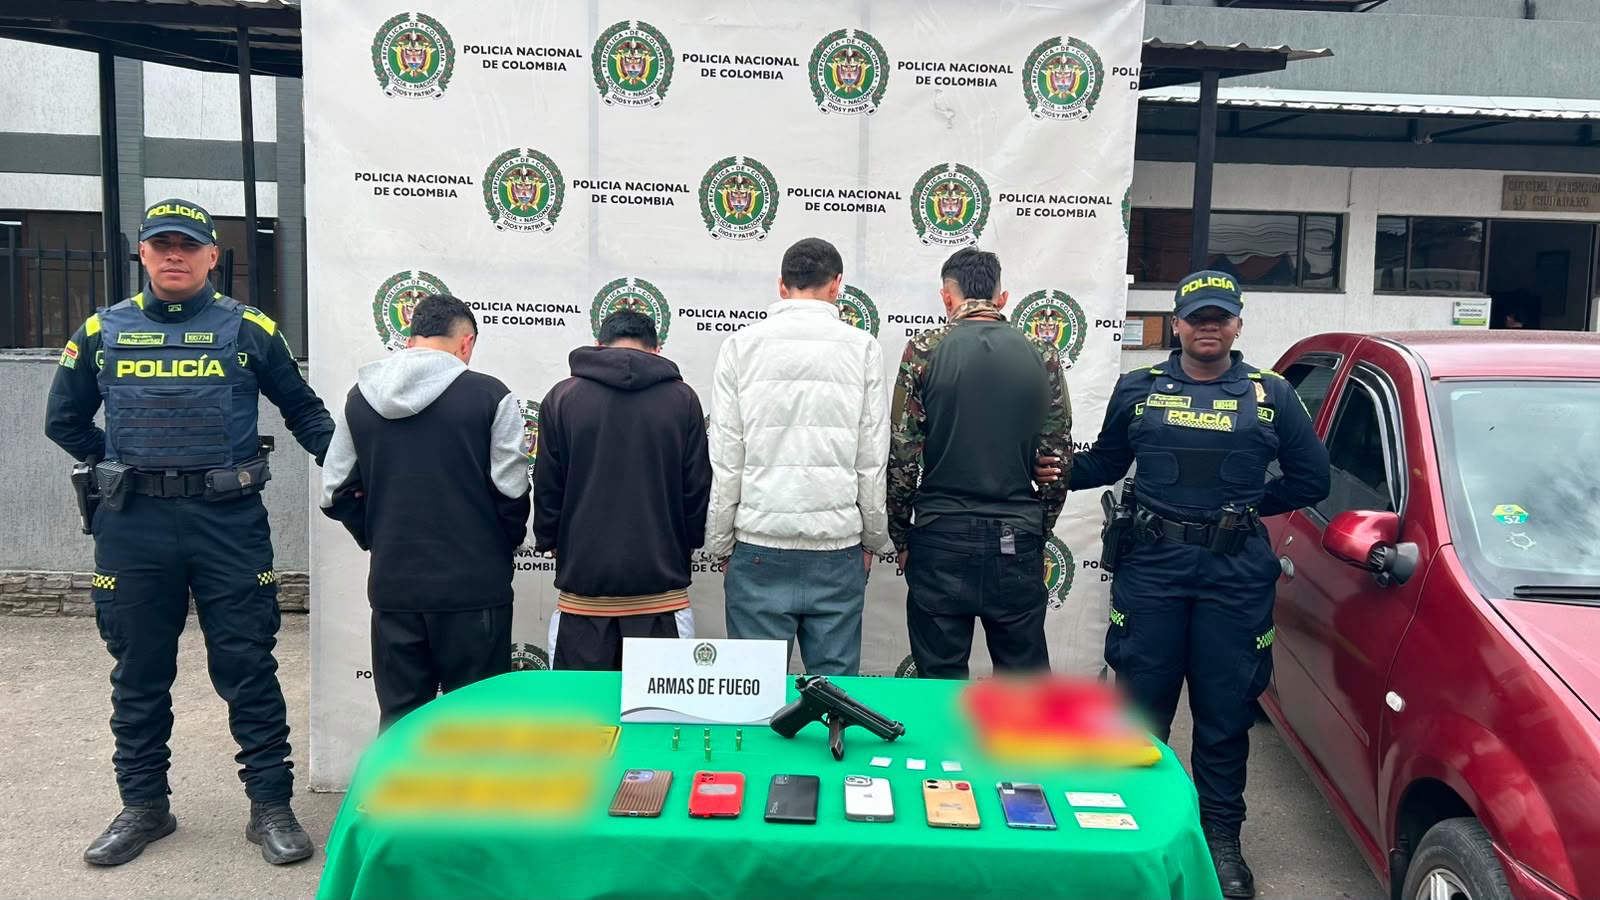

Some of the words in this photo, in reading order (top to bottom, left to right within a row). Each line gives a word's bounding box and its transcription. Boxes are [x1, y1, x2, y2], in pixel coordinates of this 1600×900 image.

[381, 25, 404, 60] REPUBLICA
[424, 26, 445, 62] COLOMBIA
[464, 45, 512, 55] POLICIA
[517, 47, 582, 57] NACIONAL
[601, 33, 624, 69] REPUBLICA
[644, 34, 664, 71] COLOMBIA
[483, 60, 497, 68] DE
[502, 61, 566, 71] COLOMBIA
[683, 54, 730, 64] POLICIA
[735, 56, 799, 66] NACIONAL
[817, 42, 840, 77] REPUBLICA
[860, 43, 880, 79] COLOMBIA
[898, 62, 945, 71] POLICIA
[950, 63, 1013, 73] NACIONAL
[1032, 49, 1054, 83] REPUBLICA
[1074, 50, 1094, 85] COLOMBIA
[1113, 67, 1138, 76] POLI
[386, 67, 407, 88] POLICIA
[413, 68, 442, 89] NACIONAL
[701, 69, 716, 77] DE
[720, 69, 783, 79] COLOMBIA
[606, 76, 627, 97] POLICIA
[633, 77, 662, 98] NACIONAL
[916, 76, 930, 84] DE
[935, 77, 997, 87] COLOMBIA
[413, 87, 436, 98] PATRIA
[822, 84, 843, 104] POLICIA
[849, 85, 877, 106] NACIONAL
[633, 96, 655, 107] PATRIA
[1037, 90, 1057, 110] POLICIA
[1063, 91, 1091, 111] NACIONAL
[849, 104, 871, 114] PATRIA
[1063, 109, 1085, 119] PATRIA
[355, 173, 403, 182] POLICIA
[408, 174, 473, 184] NACIONAL
[492, 161, 514, 195] REPUBLICA
[535, 162, 555, 198] COLOMBIA
[574, 180, 621, 190] POLICIA
[626, 182, 689, 192] NACIONAL
[708, 168, 730, 203] REPUBLICA
[750, 169, 770, 205] COLOMBIA
[375, 187, 389, 195] DE
[394, 188, 457, 197] COLOMBIA
[788, 188, 834, 197] POLICIA
[839, 190, 901, 199] NACIONAL
[920, 175, 942, 209] REPUBLICA
[962, 176, 982, 211] COLOMBIA
[592, 195, 607, 203] DE
[611, 195, 674, 205] COLOMBIA
[1000, 194, 1045, 203] POLICIA
[1049, 195, 1112, 204] NACIONAL
[806, 202, 820, 210] DE
[824, 203, 886, 212] COLOMBIA
[1017, 208, 1031, 216] DE
[1034, 209, 1096, 217] COLOMBIA
[146, 204, 206, 224] POLICÍA
[497, 202, 518, 223] POLICIA
[524, 204, 552, 224] NACIONAL
[713, 209, 733, 229] POLICIA
[739, 210, 767, 230] NACIONAL
[523, 222, 545, 232] PATRIA
[924, 216, 945, 236] POLICIA
[951, 217, 979, 237] NACIONAL
[739, 228, 760, 239] PATRIA
[949, 235, 971, 245] PATRIA
[1181, 278, 1235, 296] POLICÍA
[384, 282, 405, 316] REPUBLICA
[517, 304, 580, 313] NACIONAL
[600, 290, 621, 319] EPUBLICA
[642, 291, 660, 324] COLOMBIA
[679, 309, 725, 318] POLICIA
[730, 311, 767, 319] NACIO
[852, 298, 869, 331] COLOMBIA
[888, 315, 934, 324] POLICIA
[1020, 302, 1040, 326] PUBLICA
[1060, 303, 1077, 336] COLOMBIA
[484, 316, 498, 324] DE
[502, 316, 565, 326] COLOMBIA
[1096, 320, 1122, 328] POLI
[697, 323, 711, 331] DE
[715, 323, 745, 331] COLO
[1114, 333, 1121, 341] D
[117, 354, 224, 377] POLICÍA
[1168, 410, 1232, 426] POLICÍA
[1503, 516, 1520, 524] 52
[1048, 544, 1065, 575] COLOMBIA
[692, 564, 706, 572] DE
[648, 678, 694, 694] ARMAS
[698, 678, 715, 695] DE
[719, 679, 760, 695] FUEGO
